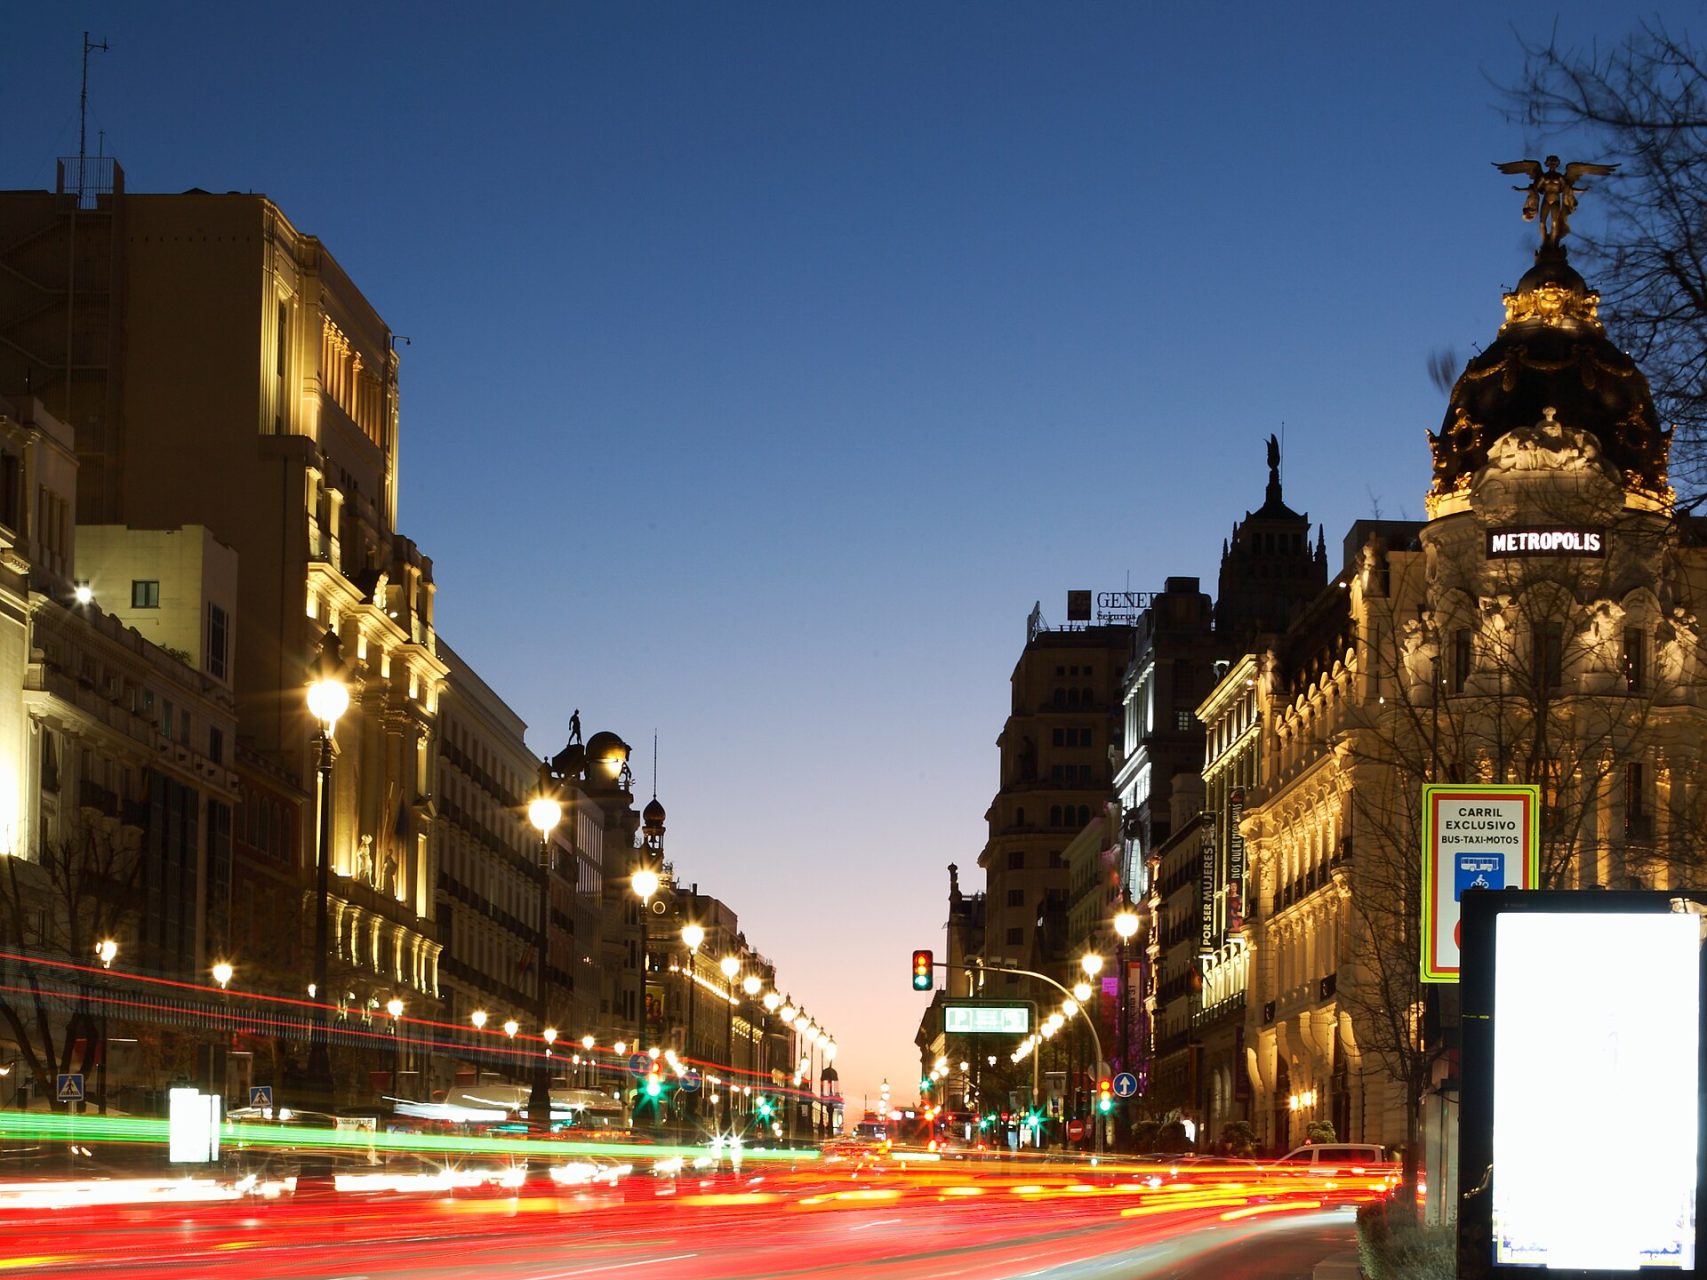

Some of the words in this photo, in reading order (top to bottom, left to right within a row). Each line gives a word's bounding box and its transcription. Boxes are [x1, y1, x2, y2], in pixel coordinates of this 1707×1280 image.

[1492, 532, 1600, 552] METROPOLIS
[1458, 808, 1503, 817] CARRIL
[1446, 821, 1516, 830] EXCLUSIVO
[1441, 836, 1519, 844] BUS-TAXI-MOTOS
[1202, 848, 1214, 902] MUJERES
[1202, 904, 1212, 921] SER
[1202, 924, 1212, 946] POR
